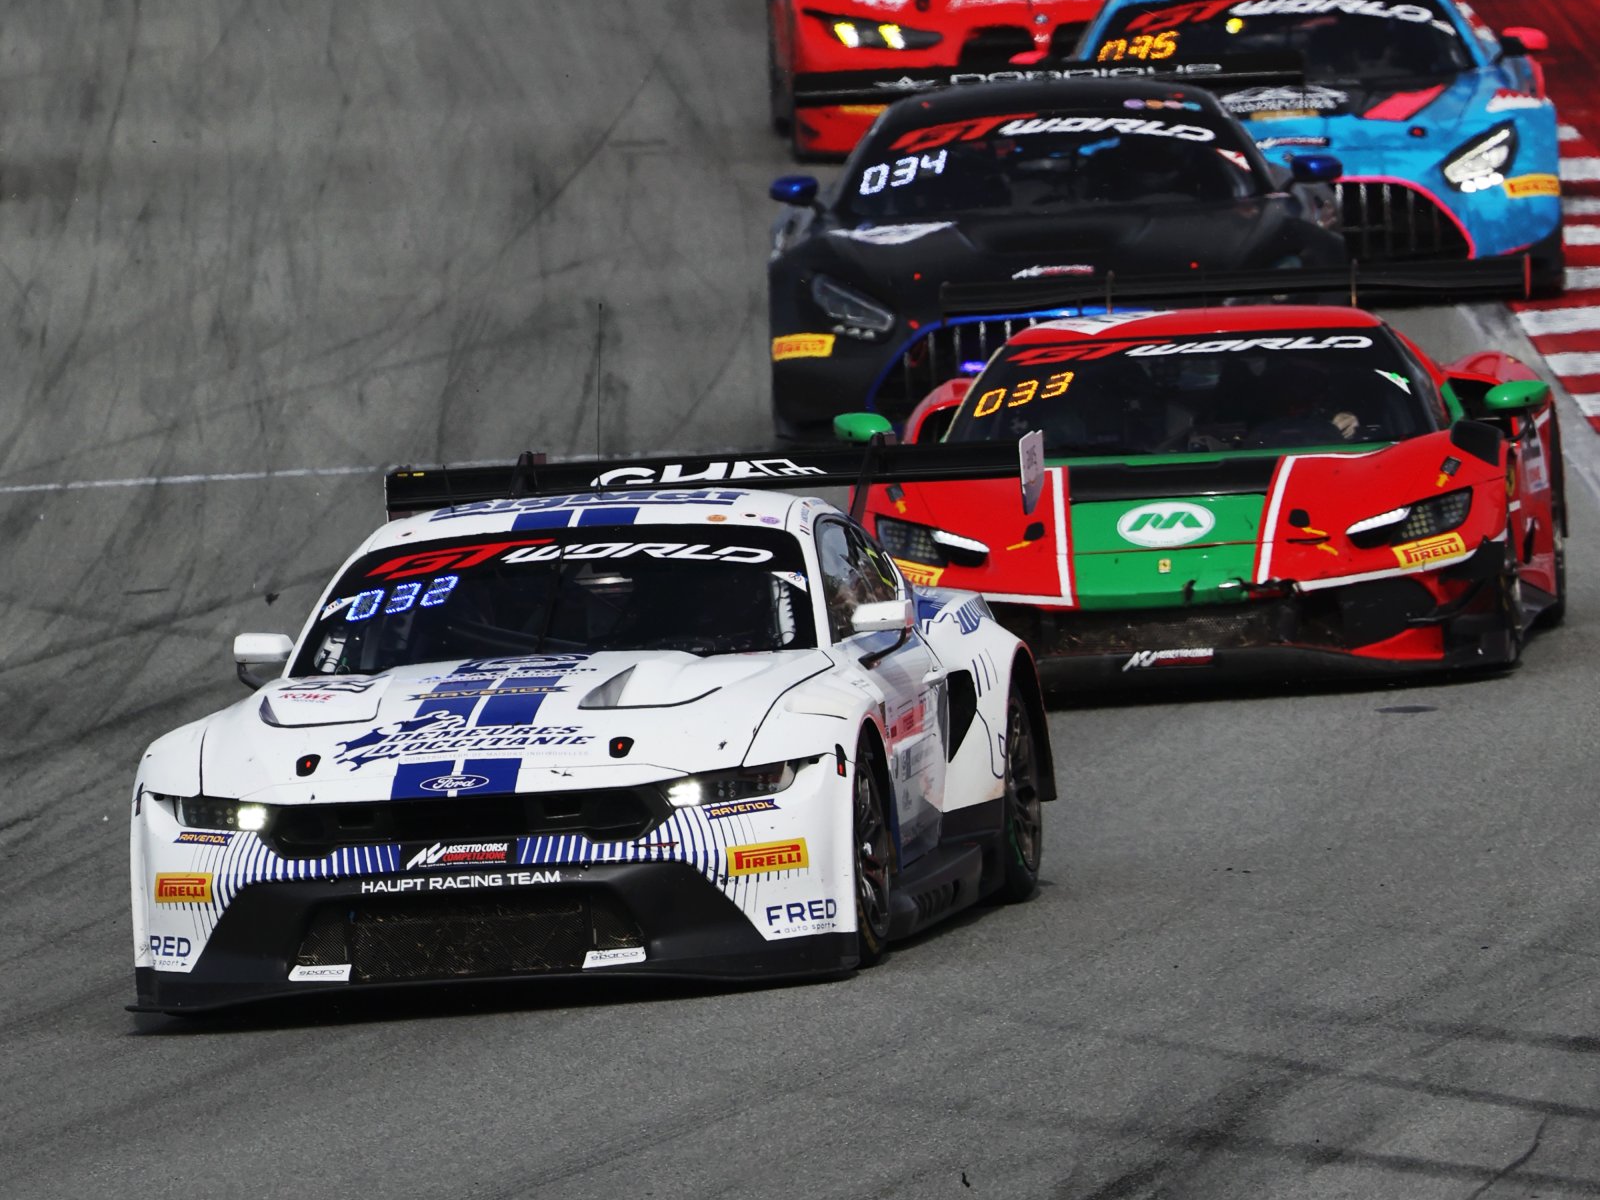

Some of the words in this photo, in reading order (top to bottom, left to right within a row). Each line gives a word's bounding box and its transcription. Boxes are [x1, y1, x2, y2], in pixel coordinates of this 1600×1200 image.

[889, 113, 1038, 154] GT
[998, 117, 1217, 142] WORLD
[859, 148, 948, 196] 034
[1006, 339, 1174, 366] GT
[1124, 336, 1374, 357] WORLD
[973, 371, 1074, 418] 033
[365, 538, 555, 580] GT
[505, 542, 774, 564] WORLD
[1402, 537, 1461, 564] PIRELLI
[345, 575, 459, 621] 032
[387, 726, 583, 743] DEMEURES
[432, 775, 476, 789] Ford
[709, 800, 773, 817] RAVENOL
[179, 833, 227, 843] RAVENOL
[446, 844, 482, 853] ASSETTO
[481, 843, 508, 852] CORSA
[443, 851, 506, 861] COMPETIZIONE
[734, 843, 801, 870] PIRELLI
[158, 878, 207, 898] PIRELLI
[361, 877, 426, 893] HAUPT
[428, 873, 503, 890] RACING
[506, 870, 561, 886] TEAM
[766, 898, 837, 926] FRED
[784, 925, 809, 934] auto
[811, 921, 832, 932] sport
[149, 934, 192, 958] RED
[590, 951, 638, 961] sparco
